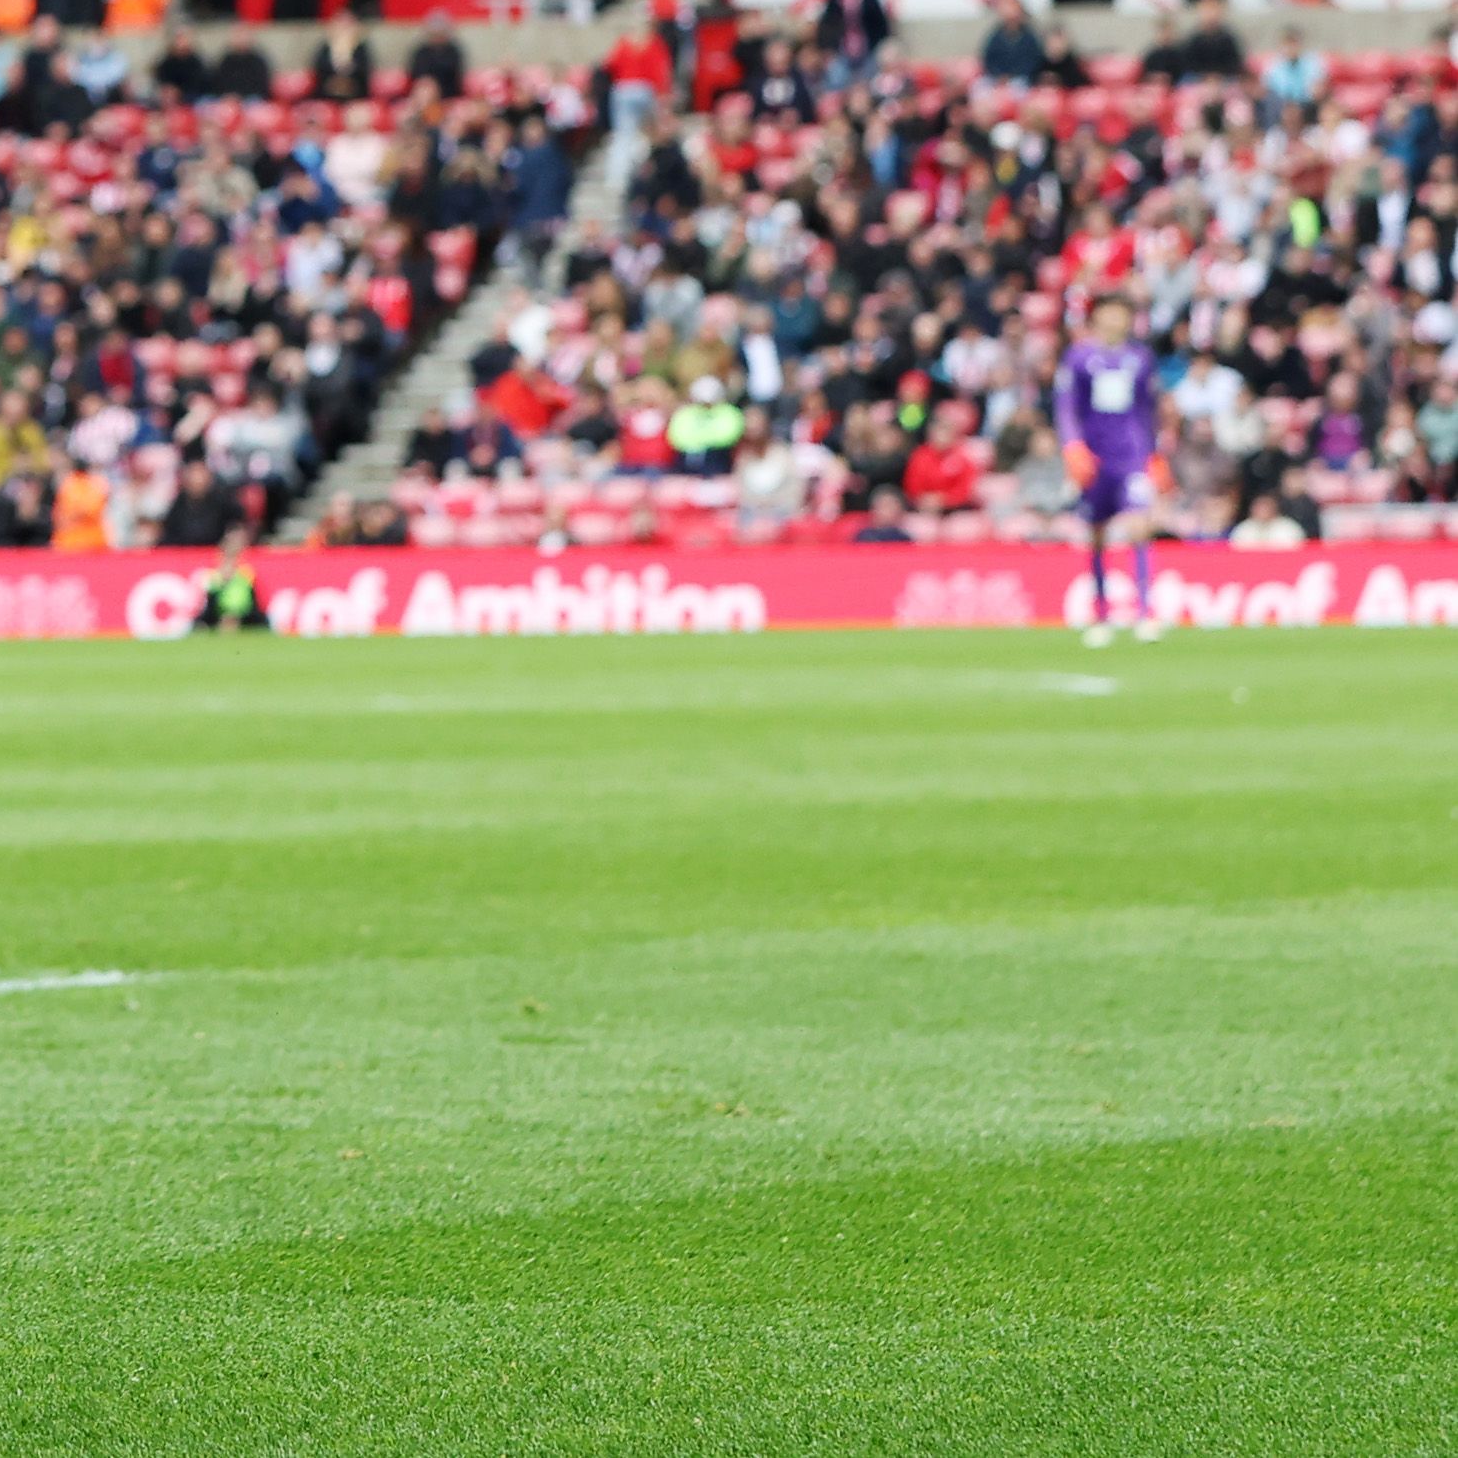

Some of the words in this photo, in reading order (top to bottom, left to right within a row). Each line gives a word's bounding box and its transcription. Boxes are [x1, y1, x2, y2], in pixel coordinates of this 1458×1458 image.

[298, 567, 387, 637] of
[401, 564, 767, 636] Ambition
[1243, 561, 1338, 628] of
